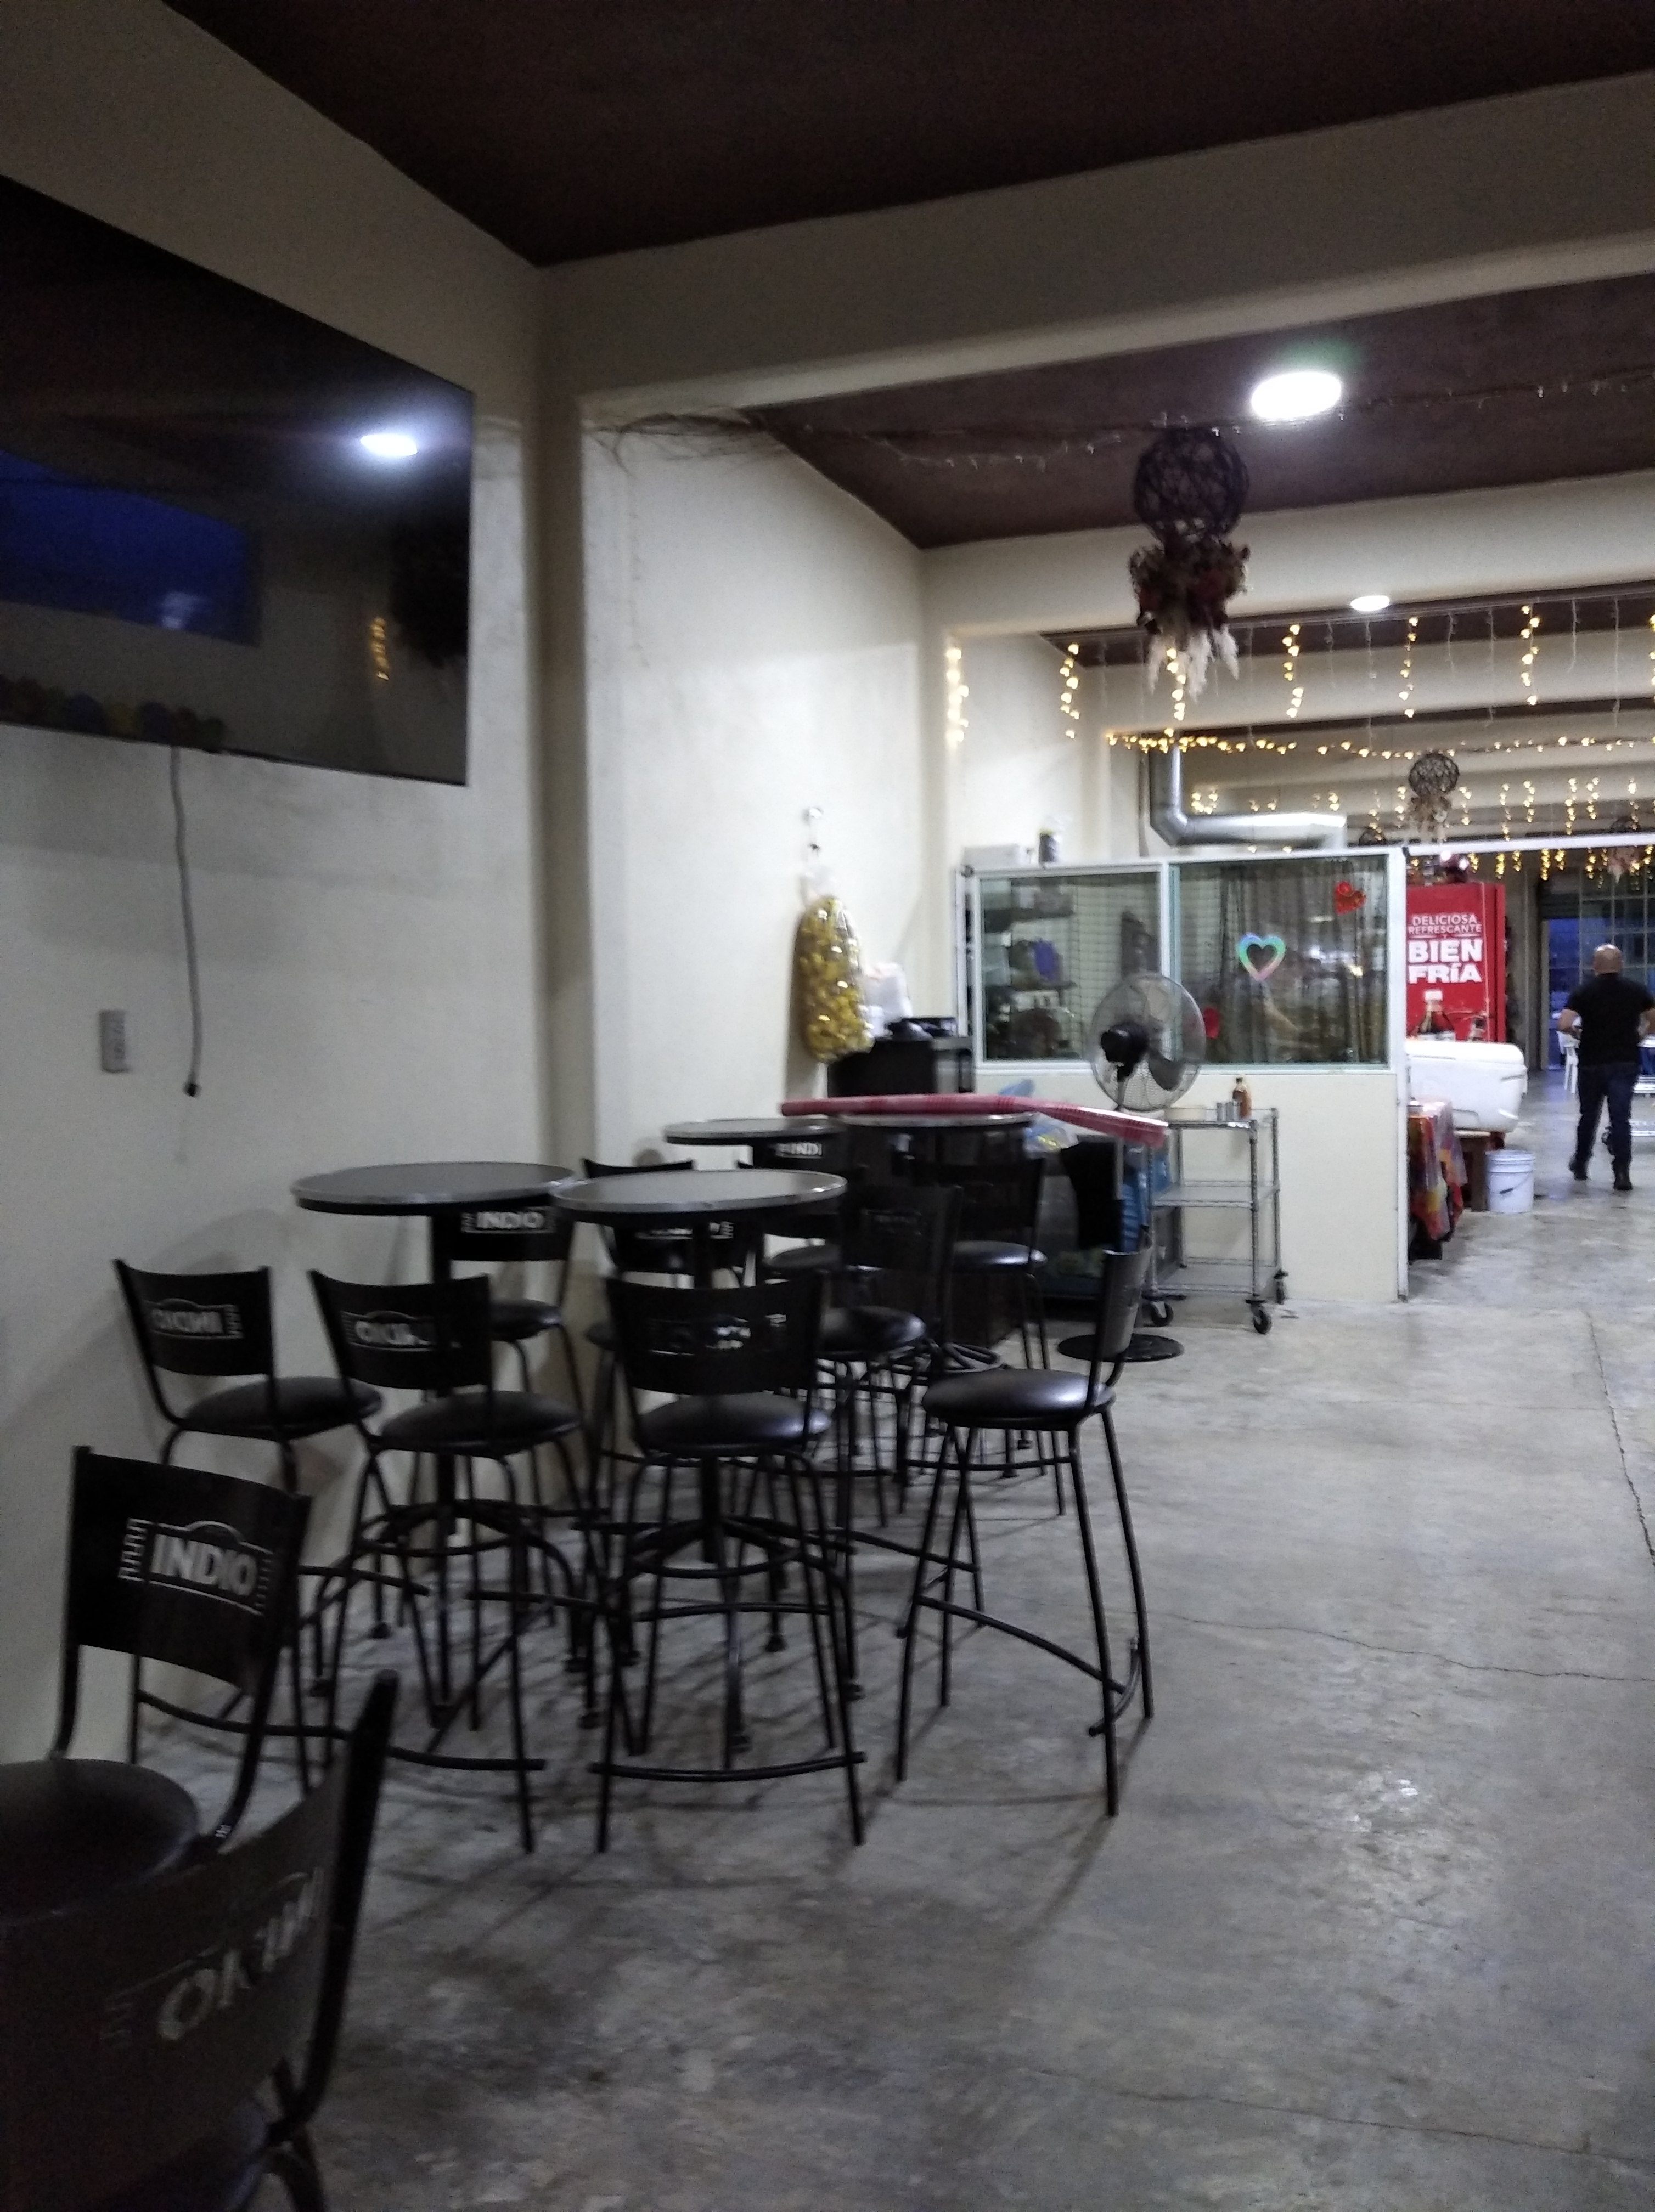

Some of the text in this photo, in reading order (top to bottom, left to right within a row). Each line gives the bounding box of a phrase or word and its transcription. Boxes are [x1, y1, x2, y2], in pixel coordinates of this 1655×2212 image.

[1408, 924, 1482, 934] REFRESCANTE
[1412, 914, 1477, 926] DELICIOSA
[1409, 939, 1482, 962] BIEN
[1409, 962, 1483, 984] FRÍA
[791, 1142, 823, 1155] INDI
[476, 1211, 544, 1229] INDIO
[150, 1534, 258, 1595] INDIO
